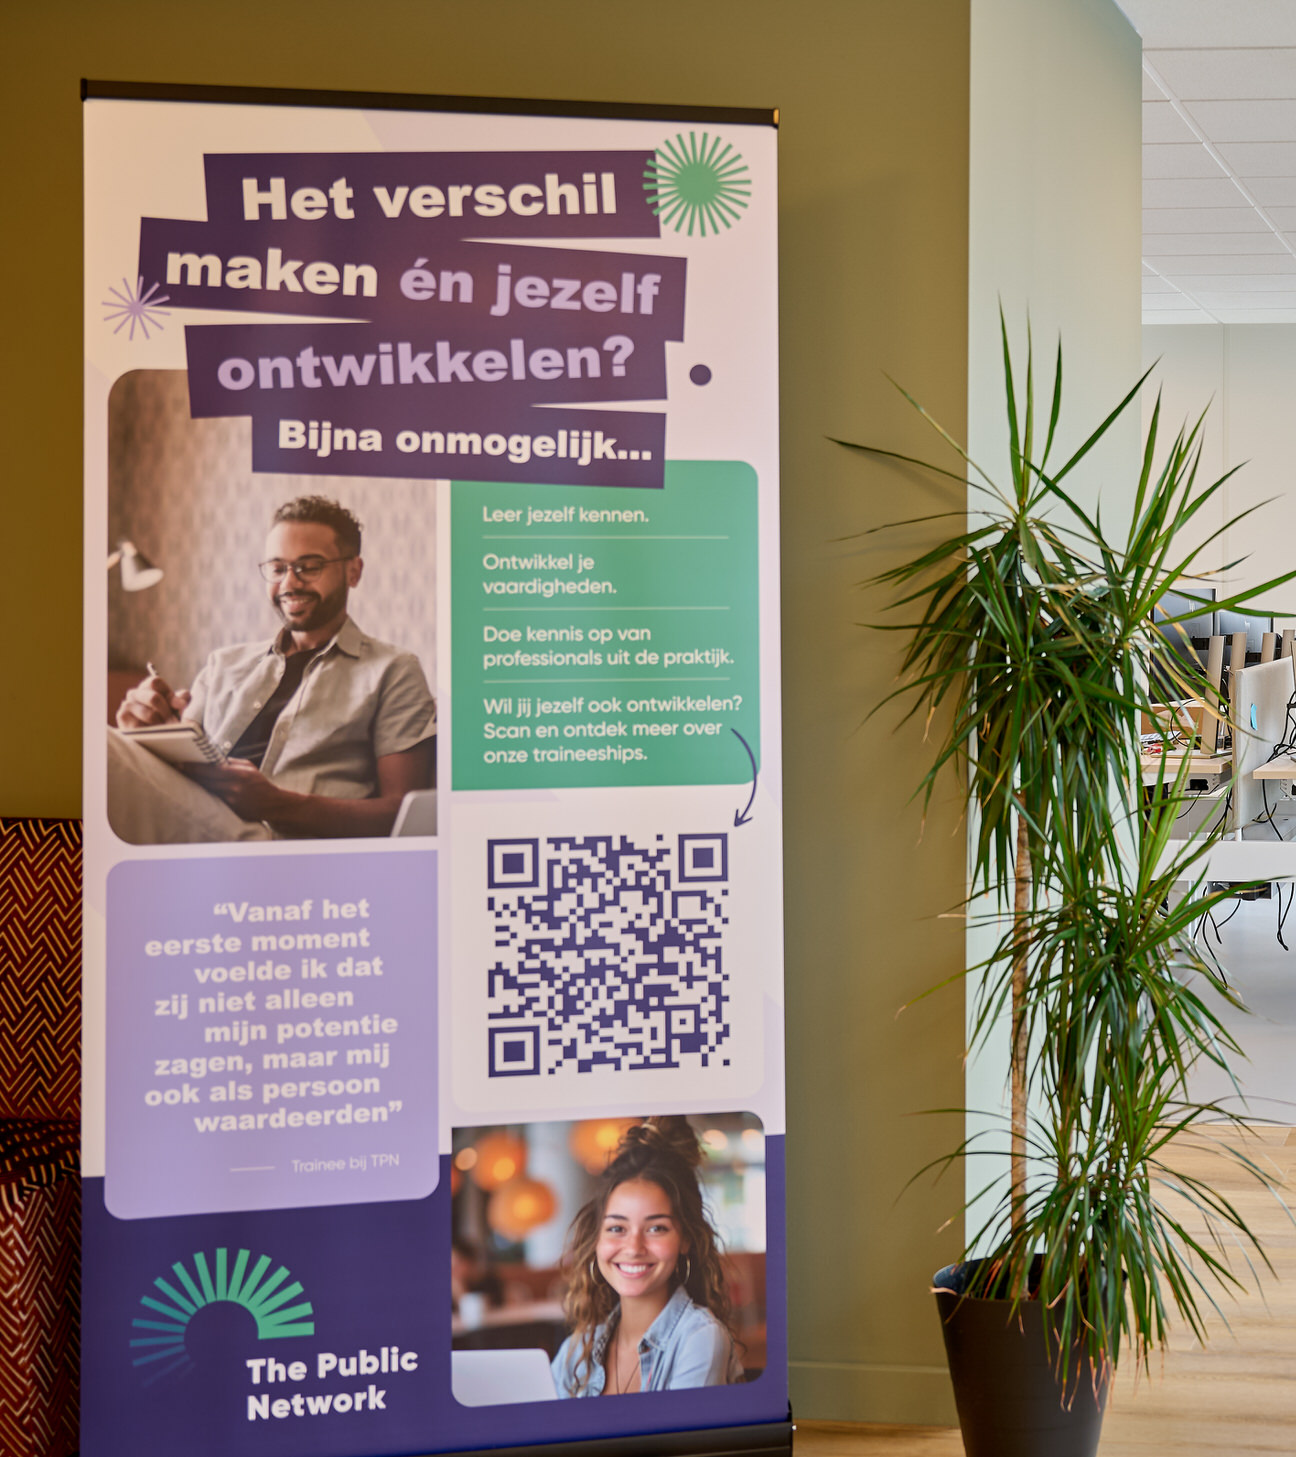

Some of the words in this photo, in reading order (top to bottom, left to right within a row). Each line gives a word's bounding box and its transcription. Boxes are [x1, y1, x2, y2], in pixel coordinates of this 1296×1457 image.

[243, 178, 354, 220] Het
[373, 173, 616, 217] verschil
[166, 248, 378, 298] maken
[400, 258, 473, 303] én
[490, 264, 661, 316] jezelf
[218, 335, 634, 390] ontwikkelen?
[279, 420, 382, 457] Bijna
[396, 430, 651, 465] onmogelijk...
[483, 506, 523, 522] Leer
[526, 506, 575, 526] jezelf
[579, 507, 649, 522] kennen.
[483, 554, 573, 570] Ontwikkel
[577, 554, 594, 573] je
[483, 578, 617, 598] vaardigheden.
[484, 626, 522, 642] Doe
[527, 626, 583, 641] kennis
[588, 629, 613, 644] op
[617, 629, 651, 641] van
[484, 649, 602, 670] professionals
[607, 649, 630, 665] uit
[635, 649, 659, 664] de
[664, 648, 734, 668] praktijk.
[484, 698, 512, 714] Wil
[517, 698, 531, 718] jij
[535, 697, 584, 717] jezelf
[588, 697, 622, 713] ook
[627, 695, 742, 712] ontwikkelen?
[484, 723, 531, 739] Scan
[536, 725, 558, 738] en
[563, 721, 627, 737] ontdek
[633, 724, 679, 736] meer
[683, 723, 722, 735] over
[484, 750, 528, 763] onze
[533, 745, 647, 764] traineeships.
[214, 900, 313, 922] “Vanaf
[323, 899, 369, 919] het
[145, 934, 241, 956] eerste
[252, 928, 370, 951] moment
[194, 960, 291, 983] voelde
[302, 958, 327, 978] ik
[337, 956, 383, 977] dat
[155, 994, 188, 1019] zij
[199, 992, 255, 1013] niet
[265, 989, 353, 1010] alleen
[205, 1021, 267, 1046] mijn
[278, 1014, 398, 1042] potentie
[155, 1054, 252, 1078] zagen,
[263, 1051, 338, 1069] maar
[347, 1043, 389, 1068] mij
[145, 1083, 200, 1106] ook
[210, 1081, 253, 1102] als
[263, 1077, 380, 1103] persoon
[194, 1101, 403, 1132] waardeerden”
[291, 1157, 346, 1173] Trainee
[349, 1156, 366, 1171] bij
[371, 1154, 399, 1167] TPN
[246, 1358, 307, 1384] The
[317, 1346, 418, 1379] Public
[247, 1386, 387, 1420] Network
